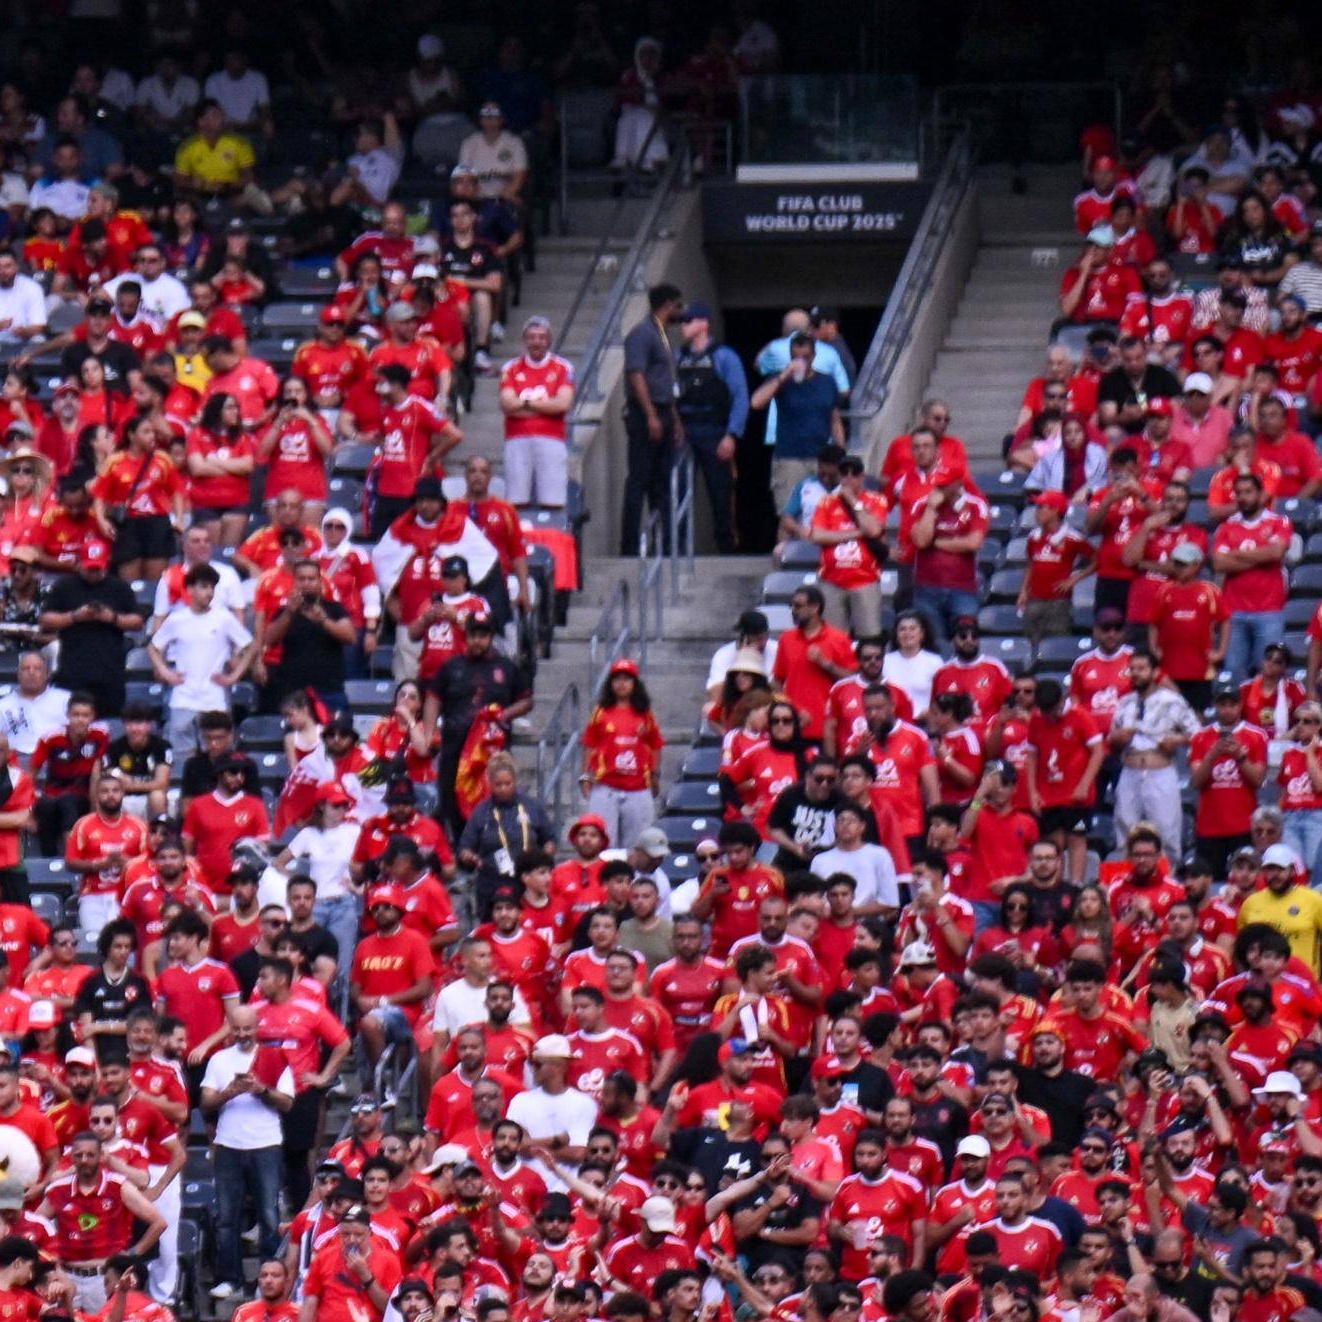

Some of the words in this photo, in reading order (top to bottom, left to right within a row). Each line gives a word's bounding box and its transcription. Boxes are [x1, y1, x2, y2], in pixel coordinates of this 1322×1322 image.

[777, 196, 815, 211] FIFA
[818, 195, 863, 211] CLUB
[745, 215, 809, 231] WORLD
[813, 215, 849, 231] CUP
